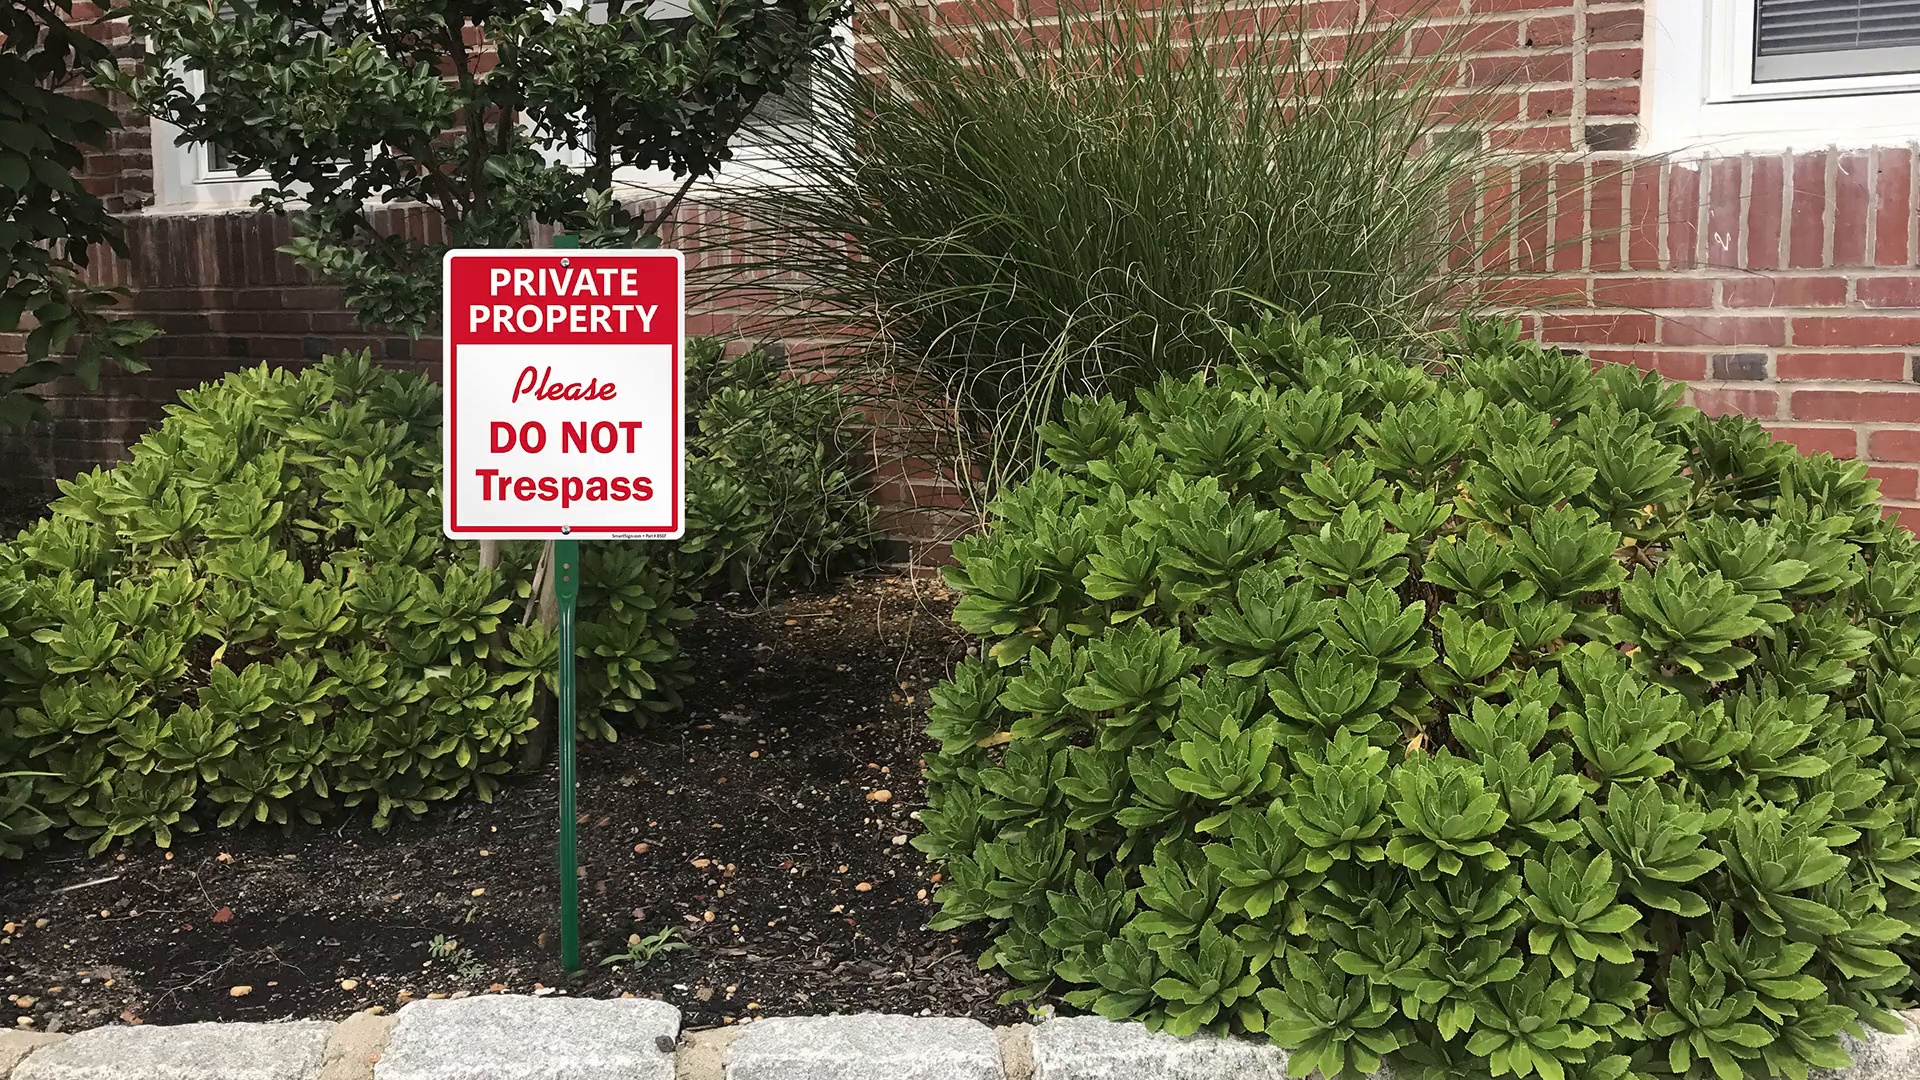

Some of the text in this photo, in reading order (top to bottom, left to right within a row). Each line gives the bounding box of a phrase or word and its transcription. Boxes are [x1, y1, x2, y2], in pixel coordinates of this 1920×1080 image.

[490, 268, 639, 297] PRIVATE
[469, 304, 659, 333] PROPERTY
[511, 365, 617, 404] Please
[489, 420, 643, 455] DO NOT
[474, 468, 654, 509] Trespass
